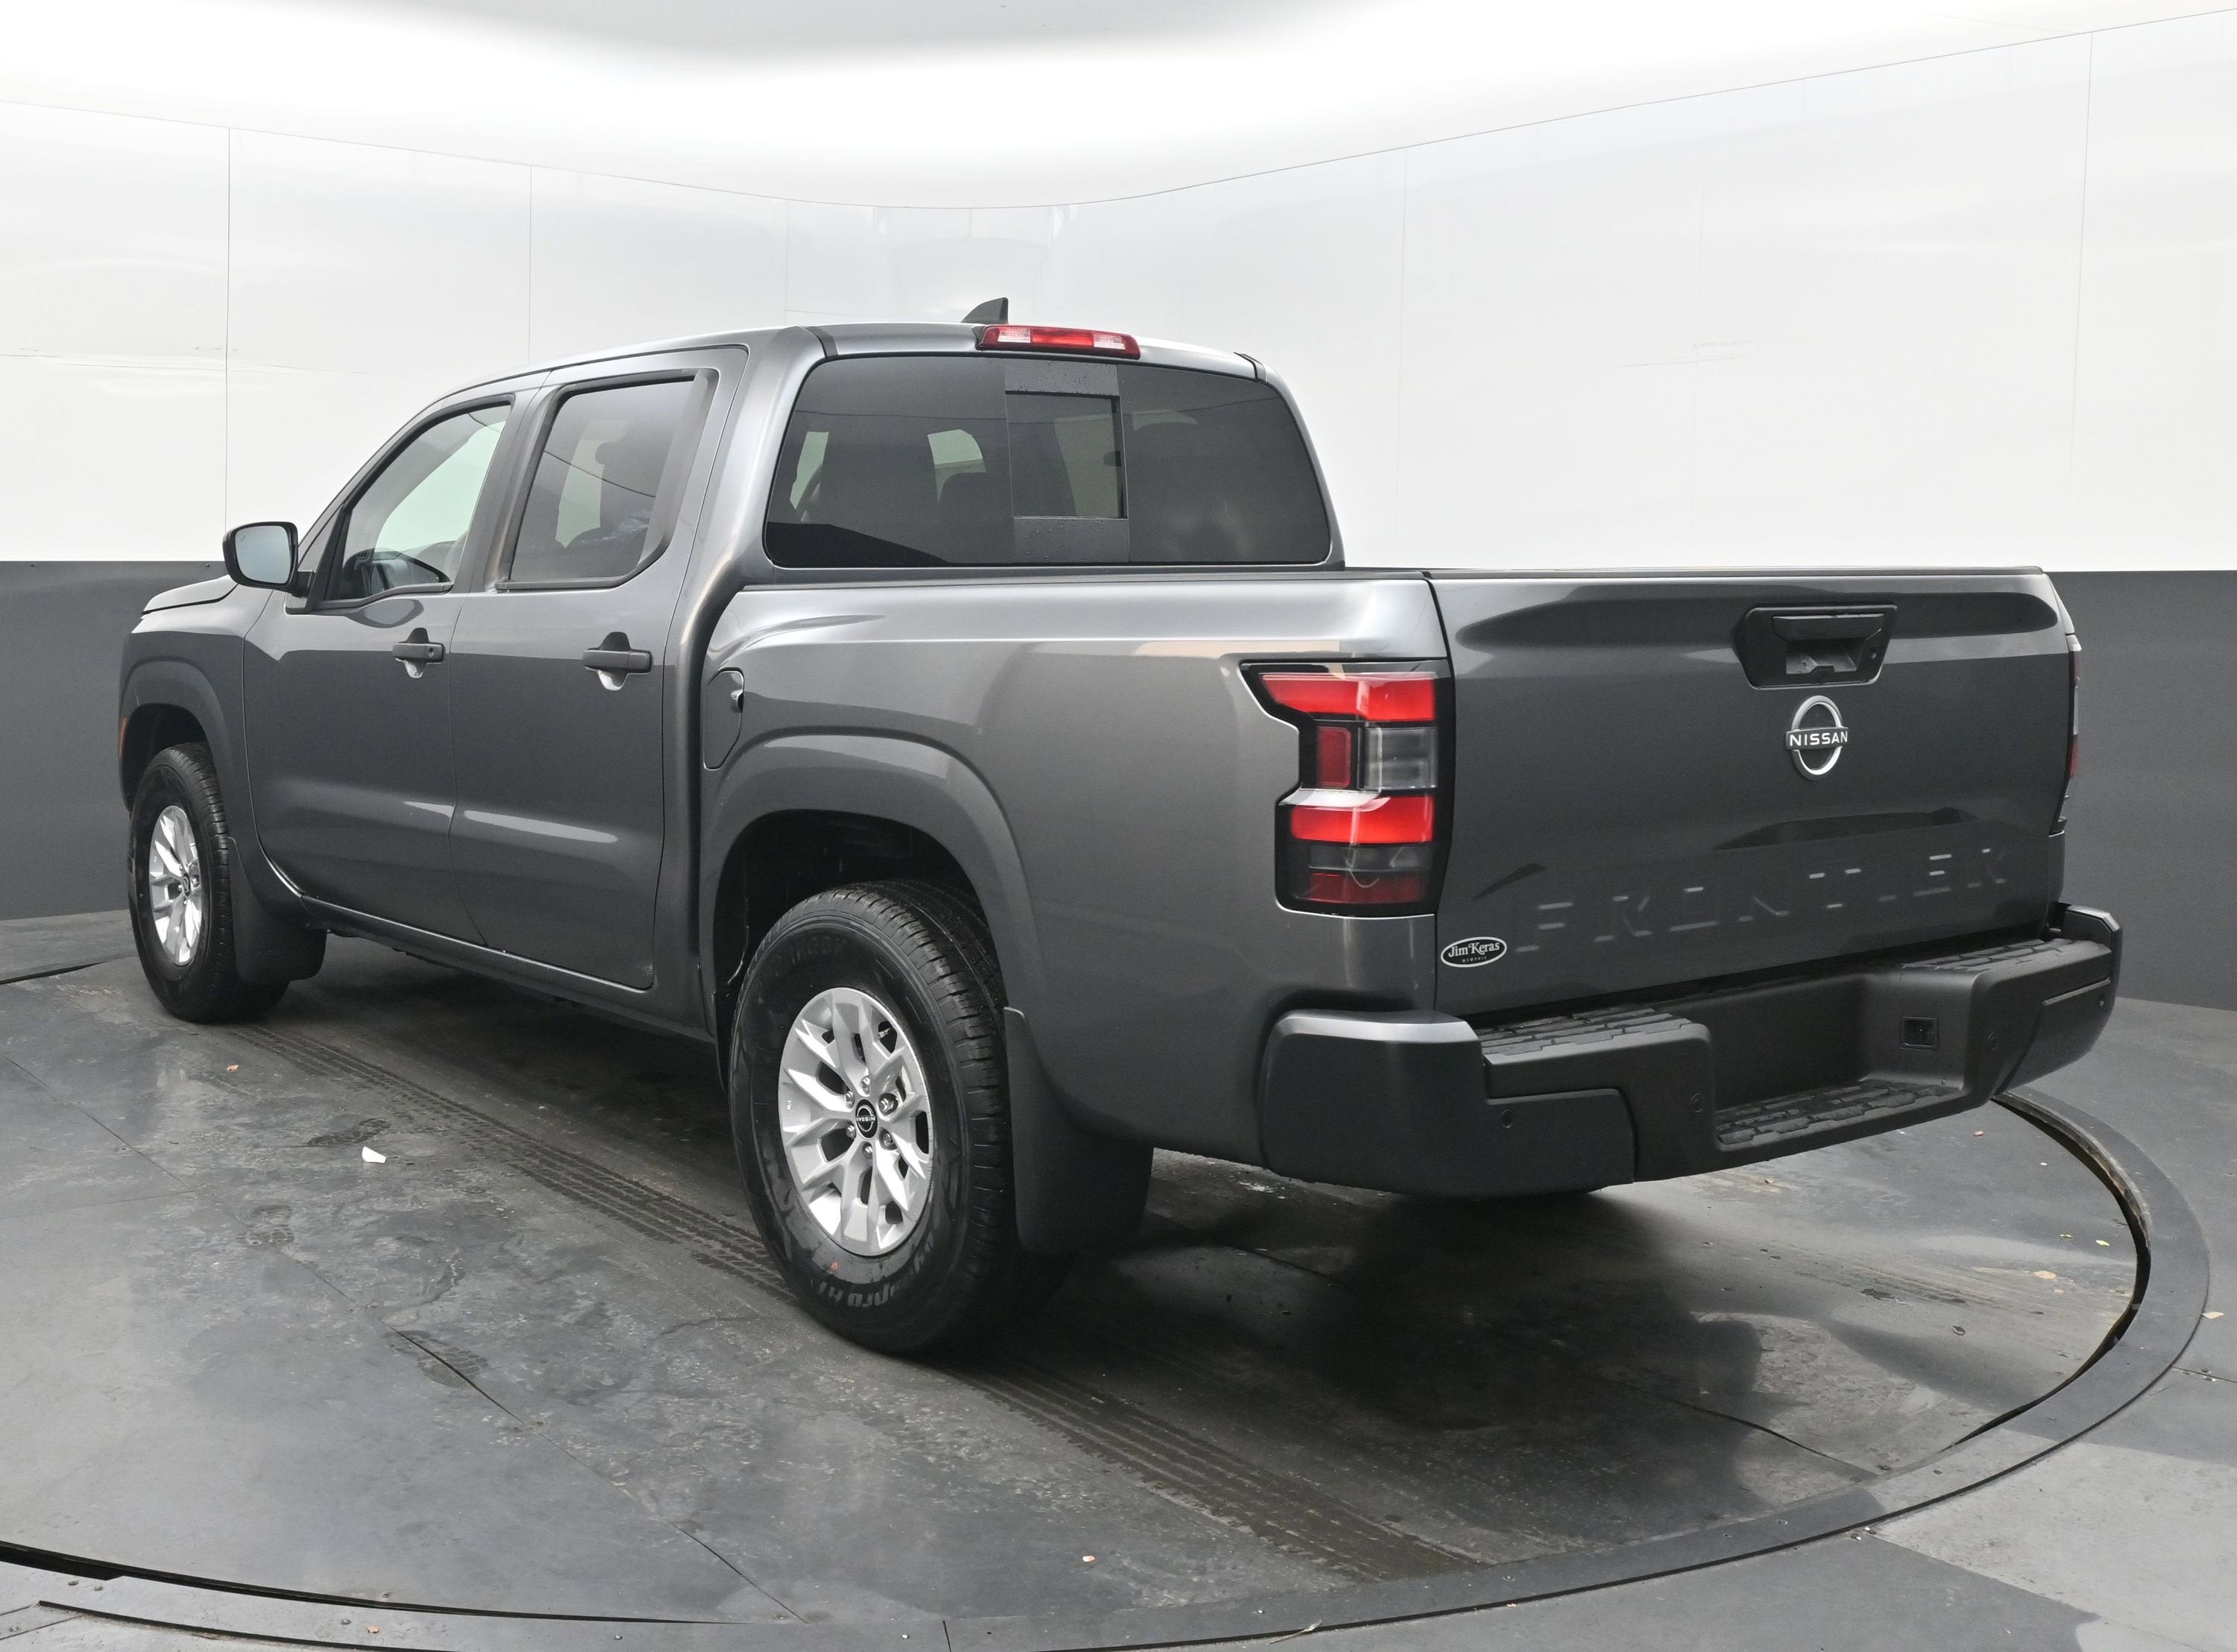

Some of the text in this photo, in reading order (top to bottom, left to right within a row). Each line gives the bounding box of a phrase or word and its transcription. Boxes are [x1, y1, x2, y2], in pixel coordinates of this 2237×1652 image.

[1790, 731, 1849, 746] NISSAN
[1449, 942, 1500, 957] Jim Keras
